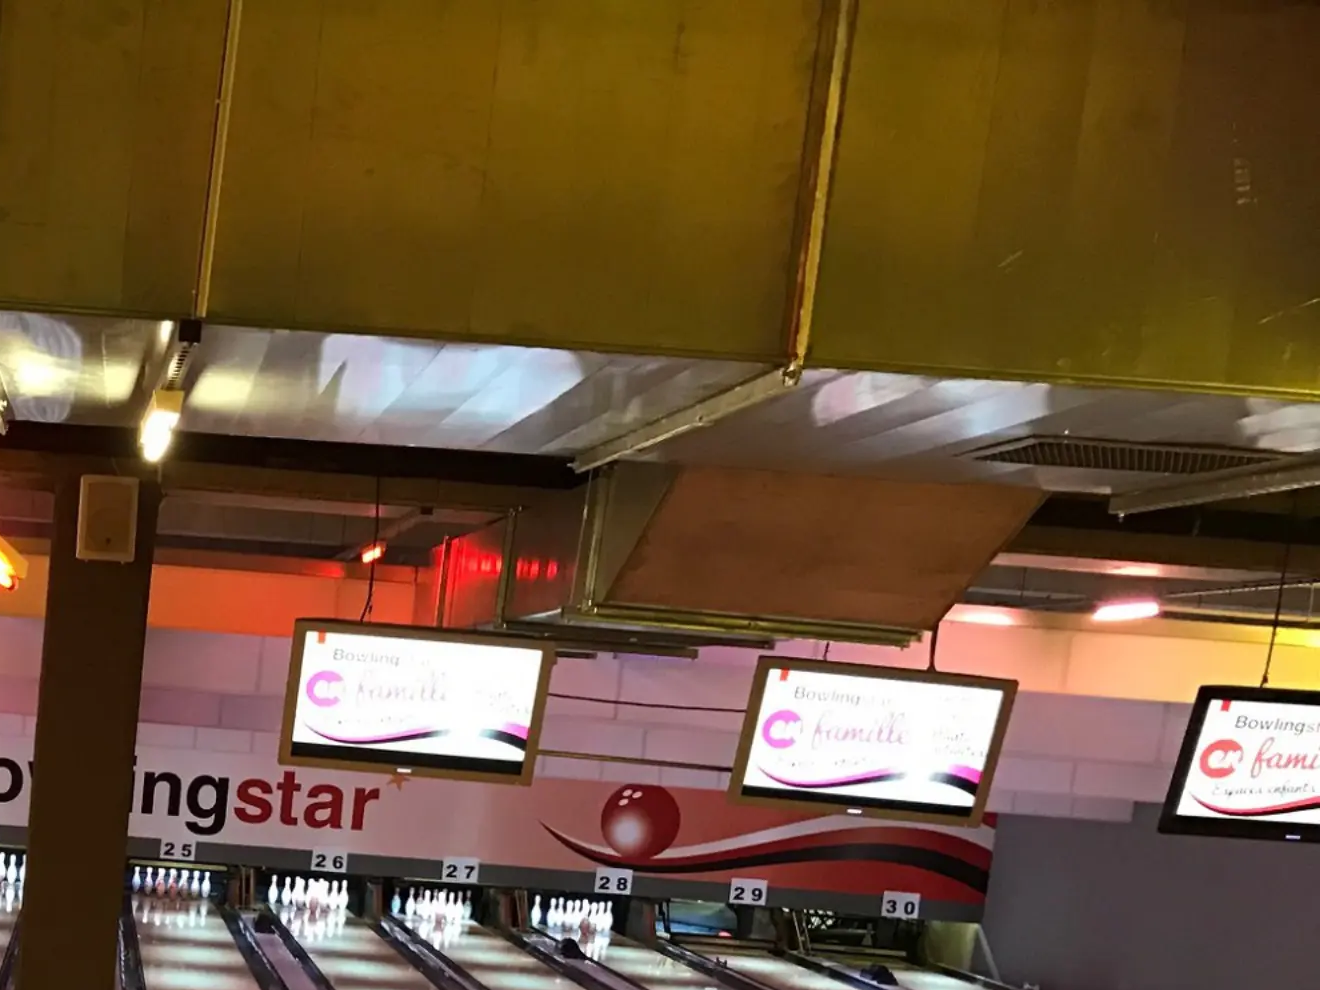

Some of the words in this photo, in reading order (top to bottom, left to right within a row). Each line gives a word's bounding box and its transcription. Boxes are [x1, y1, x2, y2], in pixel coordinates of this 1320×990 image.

[164, 842, 192, 858] 25
[314, 854, 344, 869] 26
[445, 864, 476, 880] 27
[598, 875, 628, 891] 28
[734, 887, 764, 902] 29
[885, 900, 916, 915] 30
